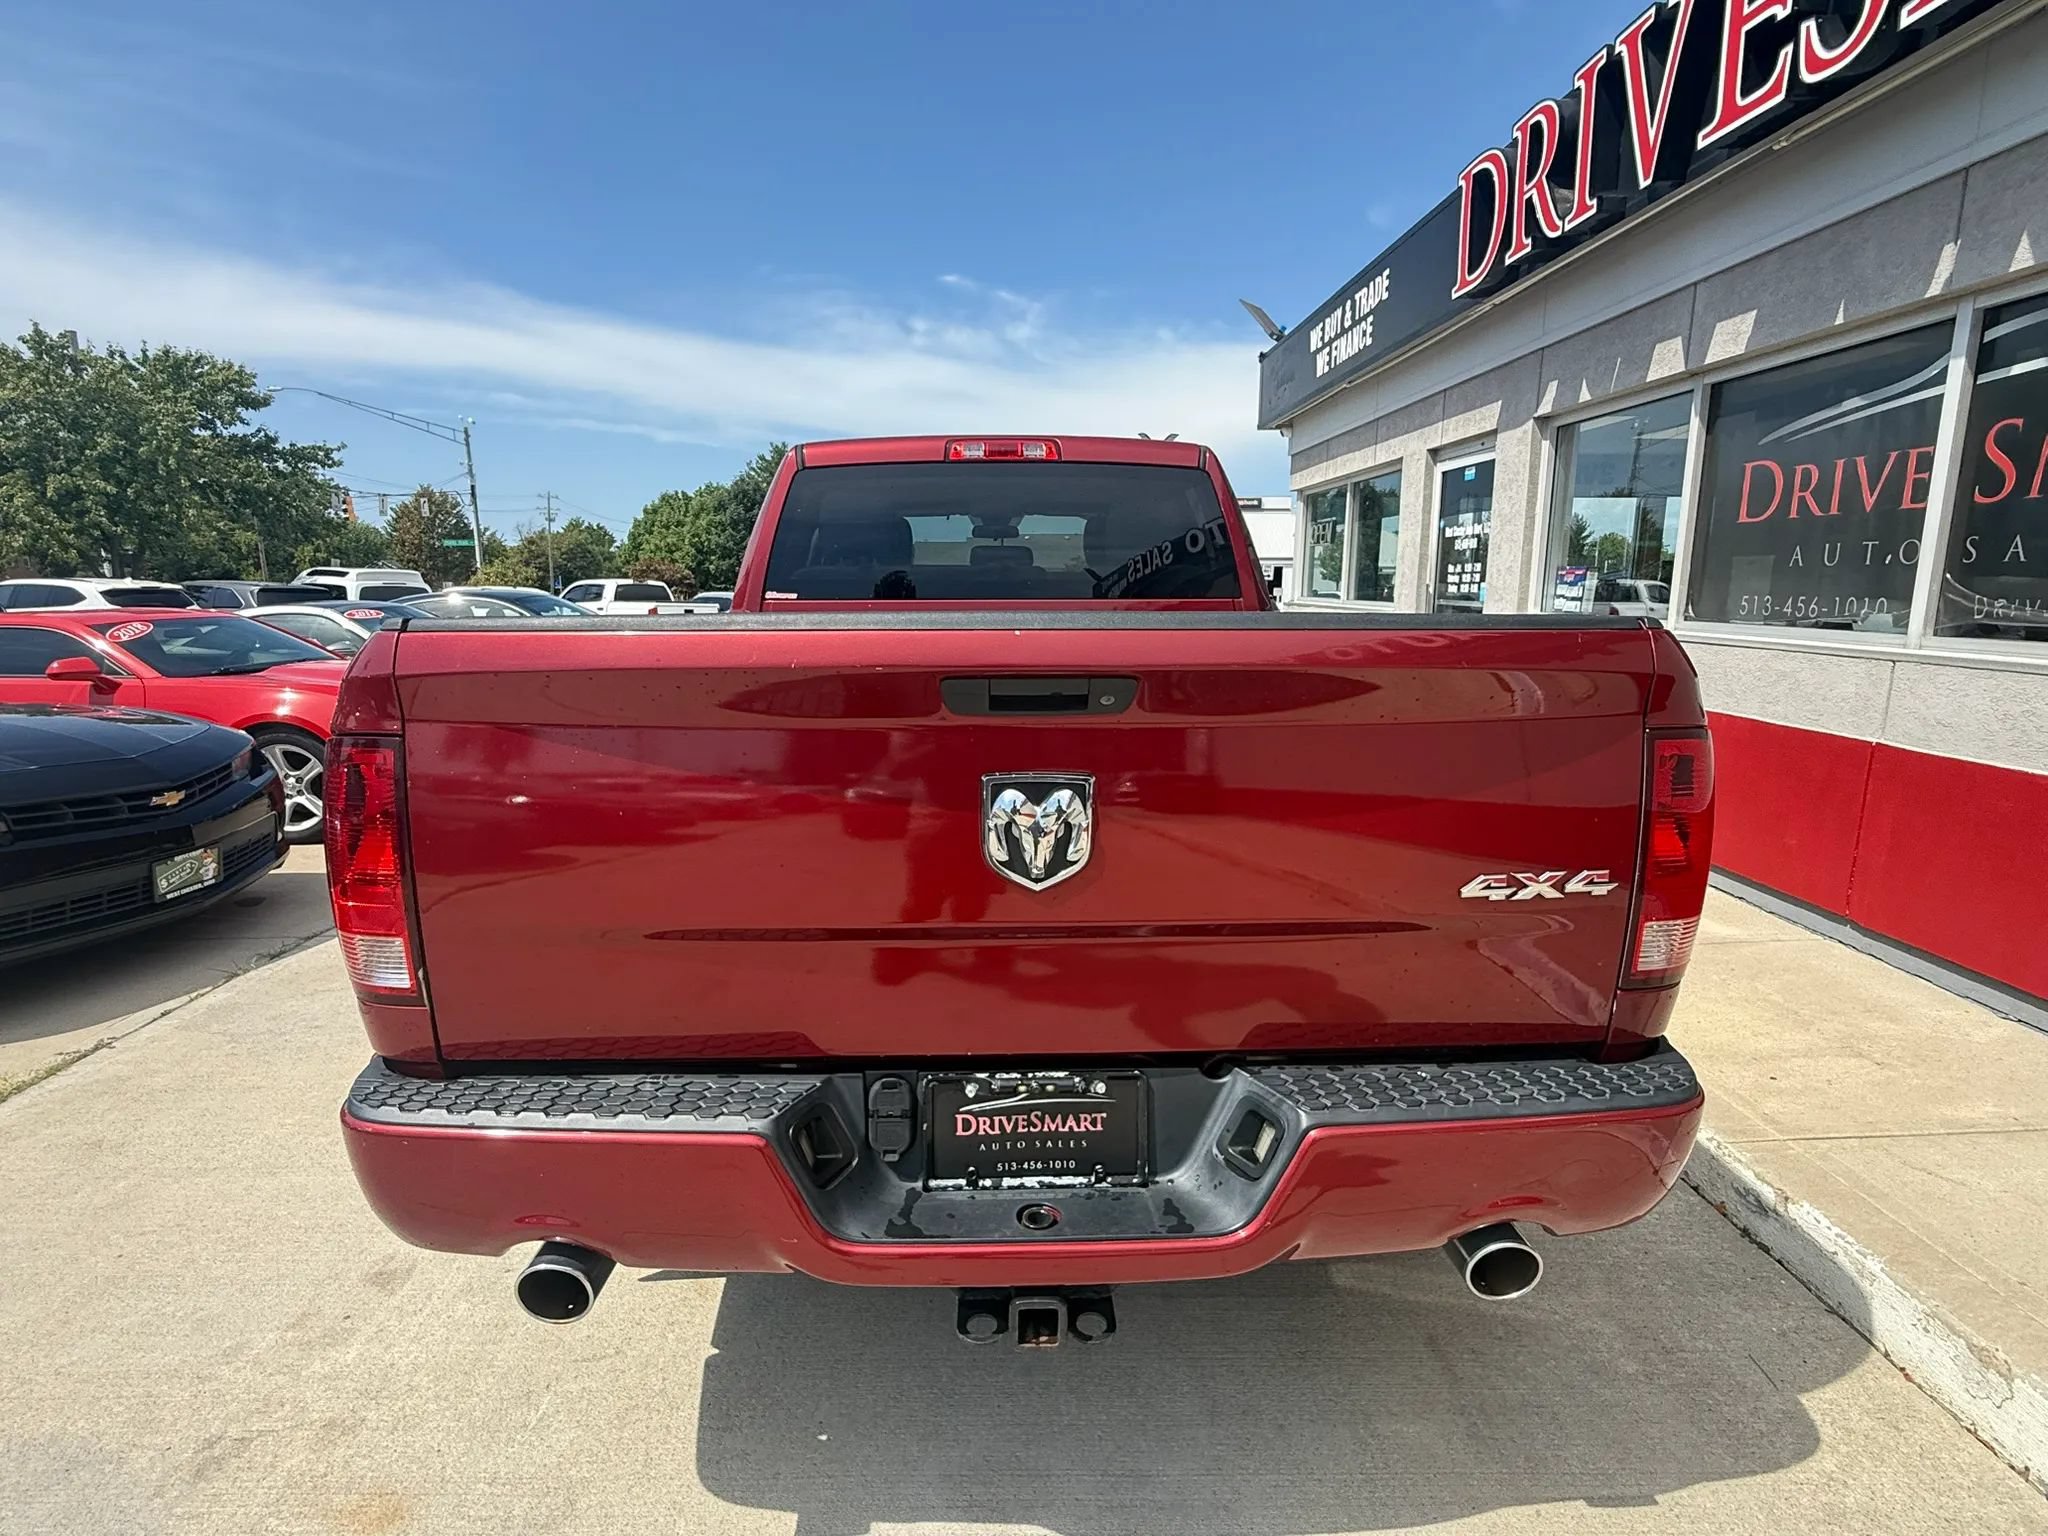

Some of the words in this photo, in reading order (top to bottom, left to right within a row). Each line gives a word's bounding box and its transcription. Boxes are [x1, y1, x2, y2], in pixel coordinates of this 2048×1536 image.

[1451, 0, 1950, 299] DRIVE
[1309, 321, 1324, 353] WE
[1324, 305, 1343, 343] BUY
[1343, 299, 1352, 329] &
[1354, 267, 1390, 320] TRADE
[1316, 345, 1330, 378] WE
[1330, 314, 1374, 369] FINANCE
[1735, 444, 1935, 524] DRIVE
[1973, 418, 2048, 504] S
[1789, 538, 1920, 568] AUTO
[1739, 595, 1888, 618] 513-456-1010
[954, 1111, 1107, 1136] DRIVESMART
[979, 1140, 1026, 1151] AUTO
[1035, 1139, 1088, 1148] SALES
[996, 1160, 1076, 1171] 513-456-1010
